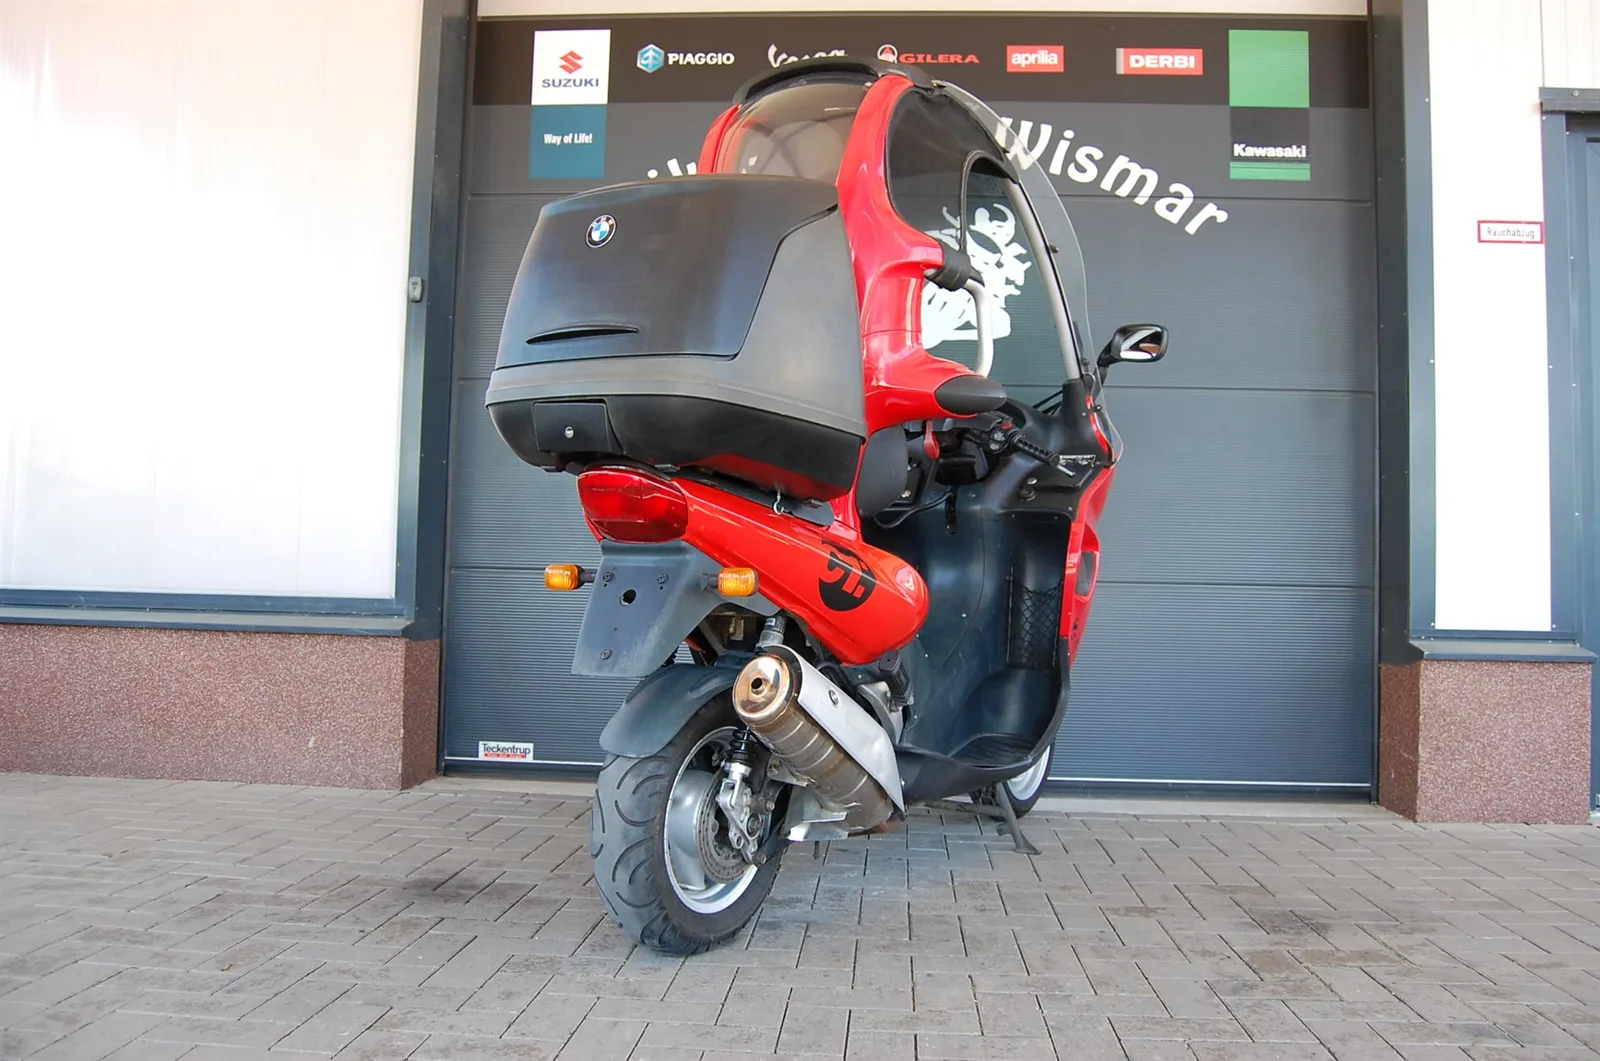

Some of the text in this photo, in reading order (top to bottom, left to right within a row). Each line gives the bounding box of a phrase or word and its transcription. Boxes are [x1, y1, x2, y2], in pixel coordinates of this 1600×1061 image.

[667, 52, 735, 65] PIAGGIO
[900, 53, 980, 64] GILERA
[1011, 50, 1058, 67] aprilia
[1129, 54, 1195, 69] DERBI
[541, 78, 600, 88] SUZUKI
[543, 132, 593, 146] Way of Life!
[1233, 143, 1307, 158] Kawasaki
[994, 117, 1229, 235] Wismar
[1486, 227, 1535, 240] Rauchabzug
[482, 743, 531, 758] Teckentrup
